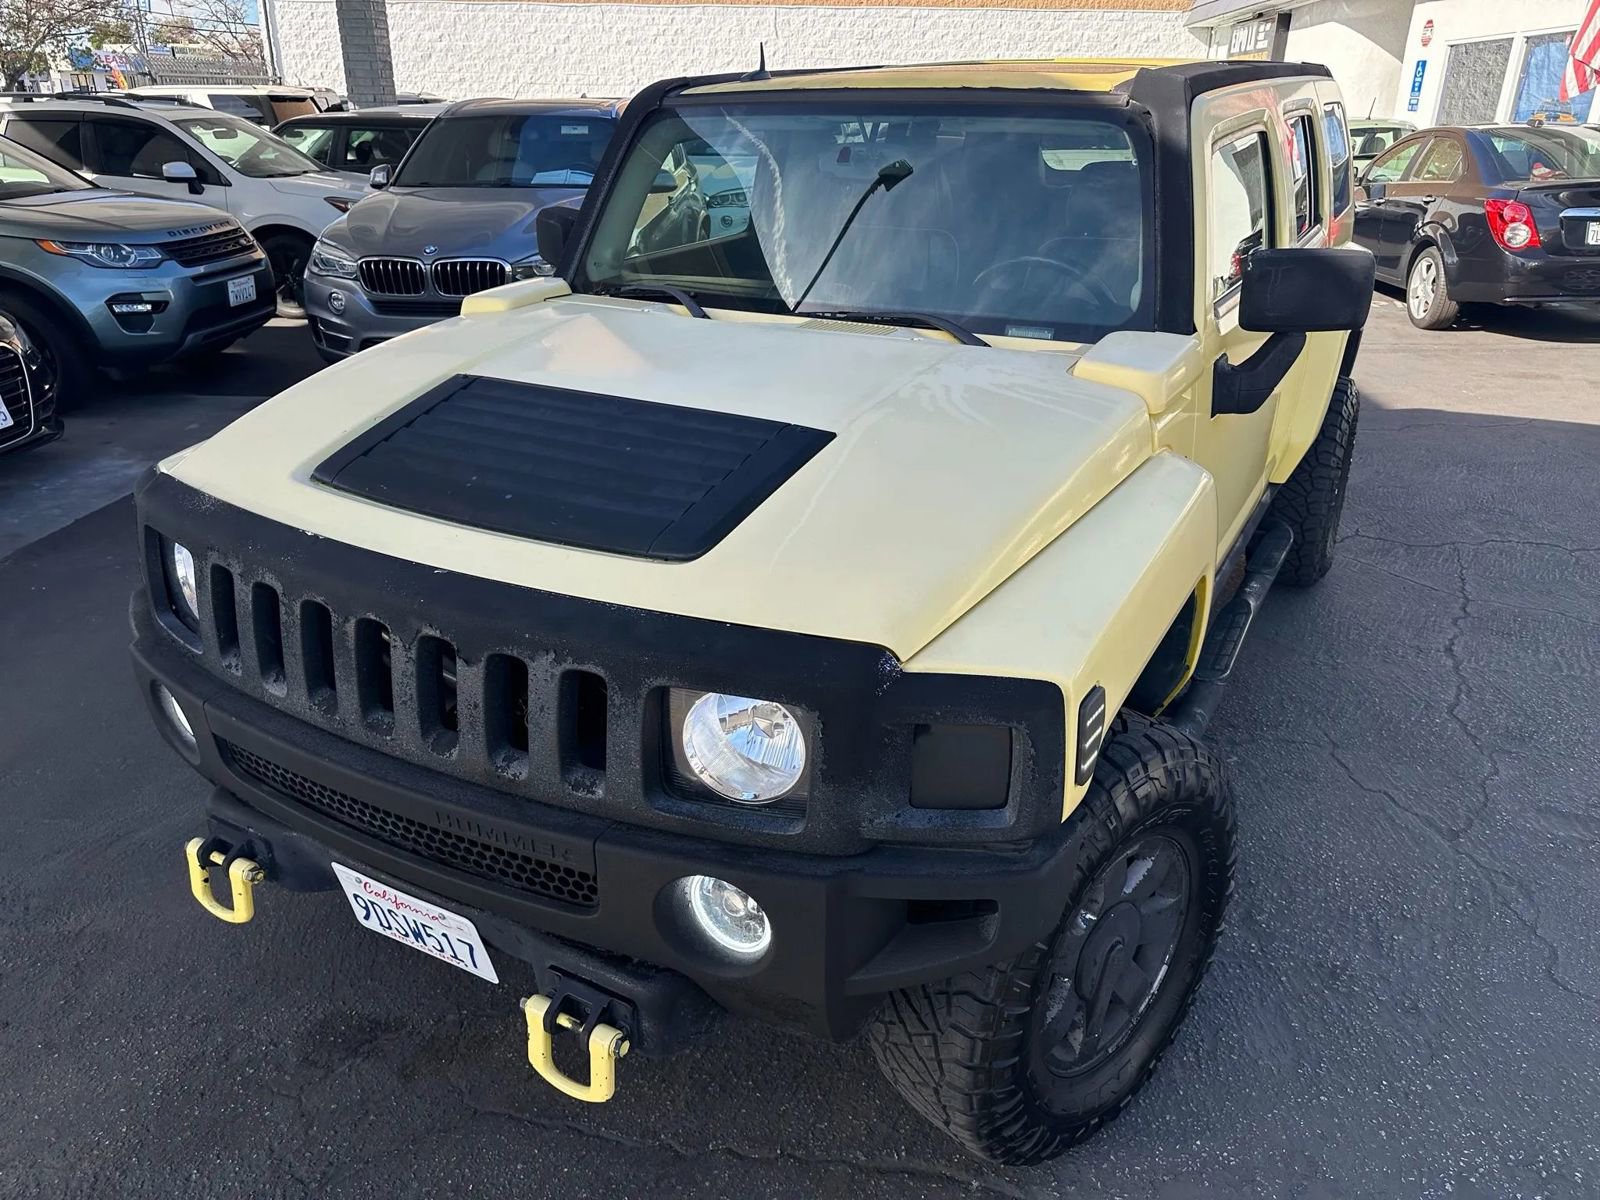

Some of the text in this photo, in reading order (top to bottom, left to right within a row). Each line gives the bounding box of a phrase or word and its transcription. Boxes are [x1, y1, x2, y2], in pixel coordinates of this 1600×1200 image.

[435, 811, 573, 862] HUMMER
[362, 881, 445, 923] California
[352, 893, 478, 969] 9DSW517
